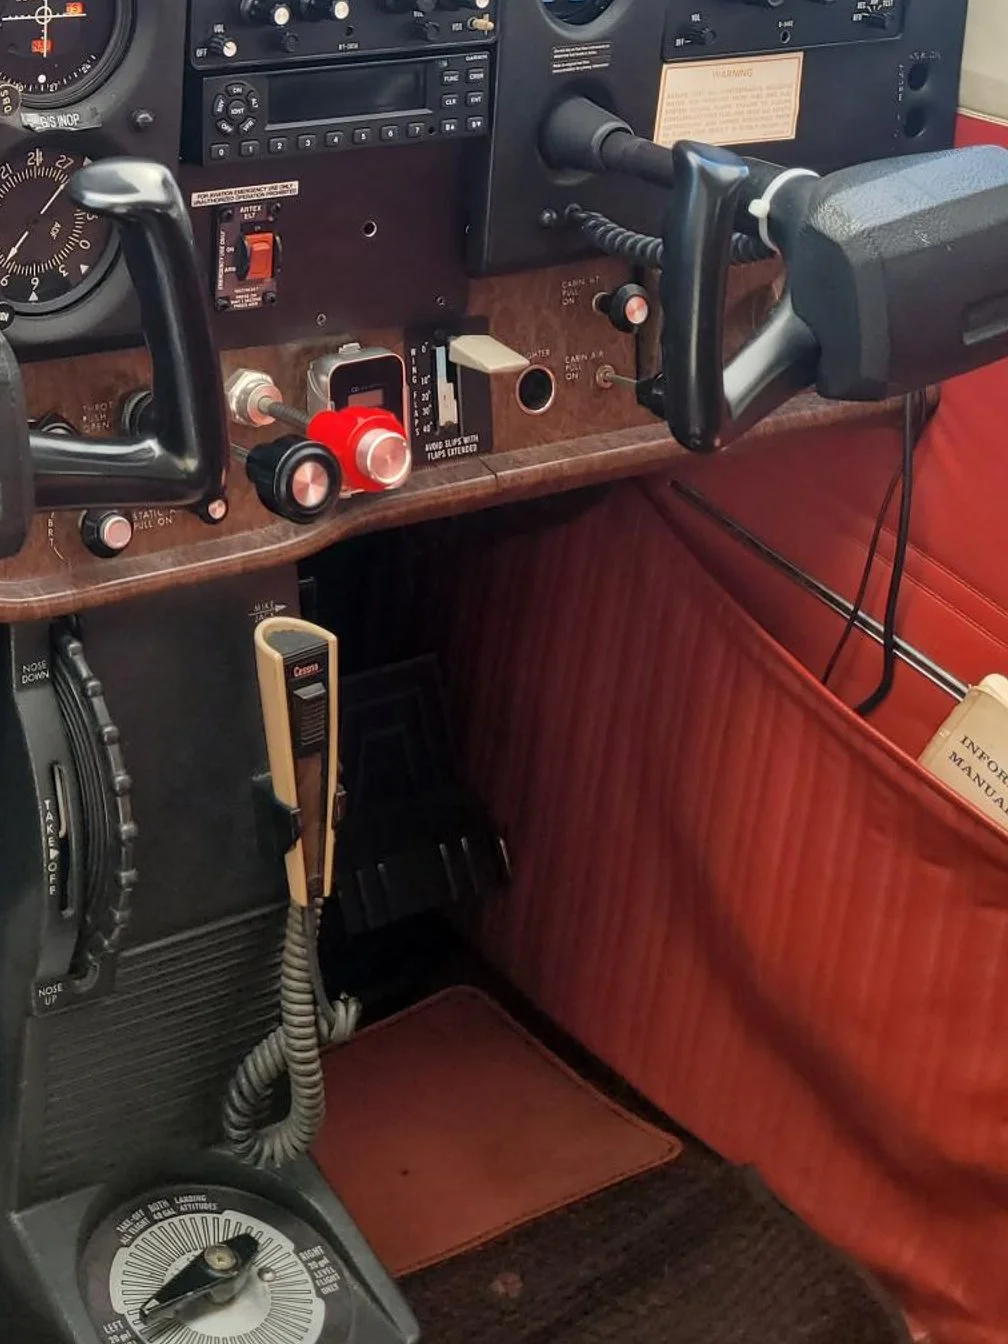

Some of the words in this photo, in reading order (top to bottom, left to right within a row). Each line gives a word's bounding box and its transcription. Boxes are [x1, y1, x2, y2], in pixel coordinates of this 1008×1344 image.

[214, 24, 224, 32] VOL
[196, 48, 207, 57] OFF
[444, 74, 458, 82] FUNC
[713, 69, 753, 78] WARNING
[0, 90, 12, 114] OBS
[562, 297, 575, 306] ON
[410, 348, 418, 384] WING
[565, 363, 583, 371] PULL
[566, 372, 579, 380] ON
[426, 441, 443, 452] AVOID
[444, 437, 462, 447] SLIPS
[463, 434, 478, 444] WITH
[428, 450, 446, 462] FLAPS
[447, 444, 477, 456] EXTENDED
[158, 517, 172, 525] ON
[23, 661, 47, 673] NOSE
[294, 663, 318, 677] Cessna
[22, 670, 49, 684] DOWN
[960, 736, 1008, 787] INFOR
[44, 800, 56, 846] TAKE
[48, 862, 57, 895] OFF
[39, 983, 62, 995] NOSE
[45, 994, 57, 1005] UP
[148, 1199, 169, 1213] BOTH
[174, 1195, 207, 1204] LANDING
[180, 1203, 217, 1211] ATTITUDES
[116, 1209, 146, 1233] TAKE-OFF
[299, 1245, 324, 1260] RIGHT
[312, 1266, 336, 1279] LEVEL
[314, 1274, 339, 1287] FLIGHT
[321, 1283, 339, 1295] ONLY
[103, 1320, 123, 1334] LEFT
